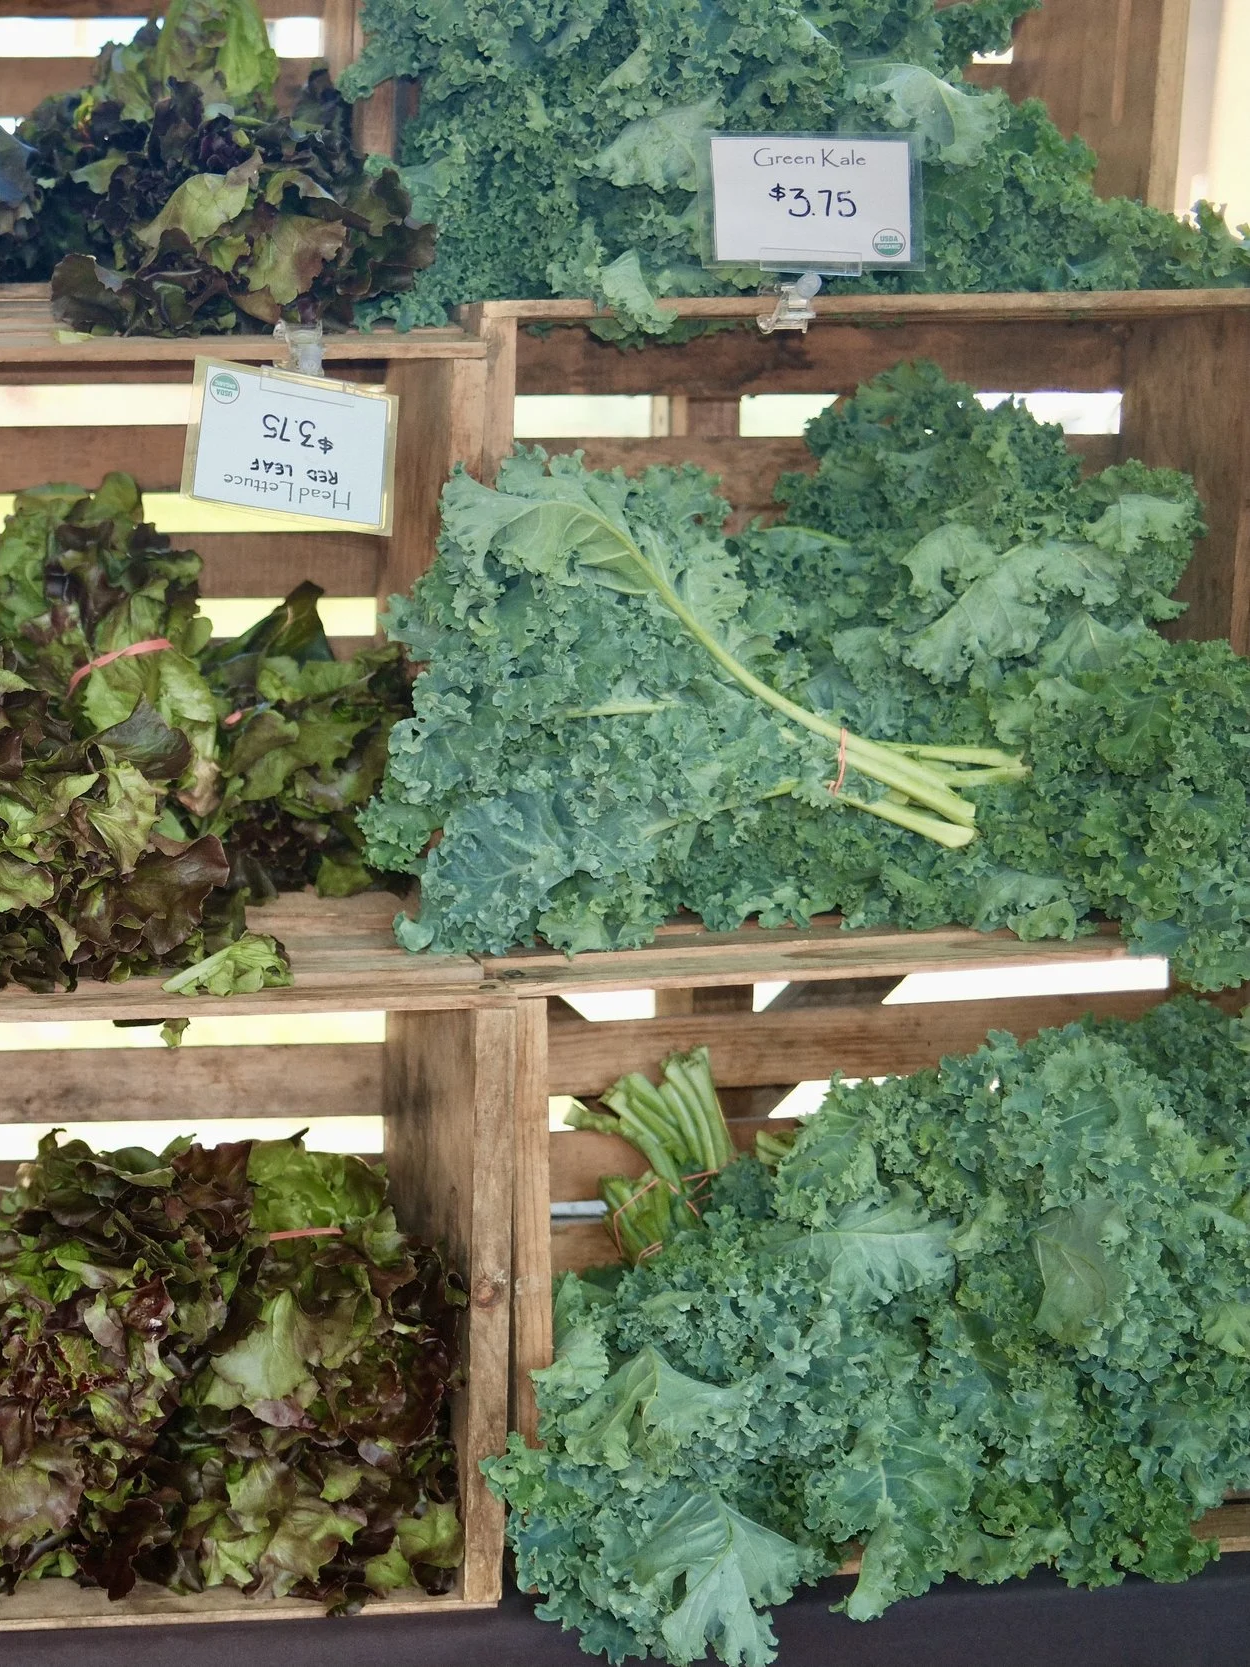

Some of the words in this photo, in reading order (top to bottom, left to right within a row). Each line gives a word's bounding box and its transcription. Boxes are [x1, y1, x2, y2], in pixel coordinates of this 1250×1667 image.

[753, 147, 815, 167] Green
[821, 148, 867, 168] Kale
[768, 182, 857, 218] $3.75
[879, 234, 899, 243] USDA
[215, 388, 233, 398] USDA
[261, 413, 334, 455] $3.75
[249, 458, 293, 477] LEAF
[306, 468, 338, 486] RED
[223, 473, 294, 502] Lettuce
[298, 487, 351, 511] Head
